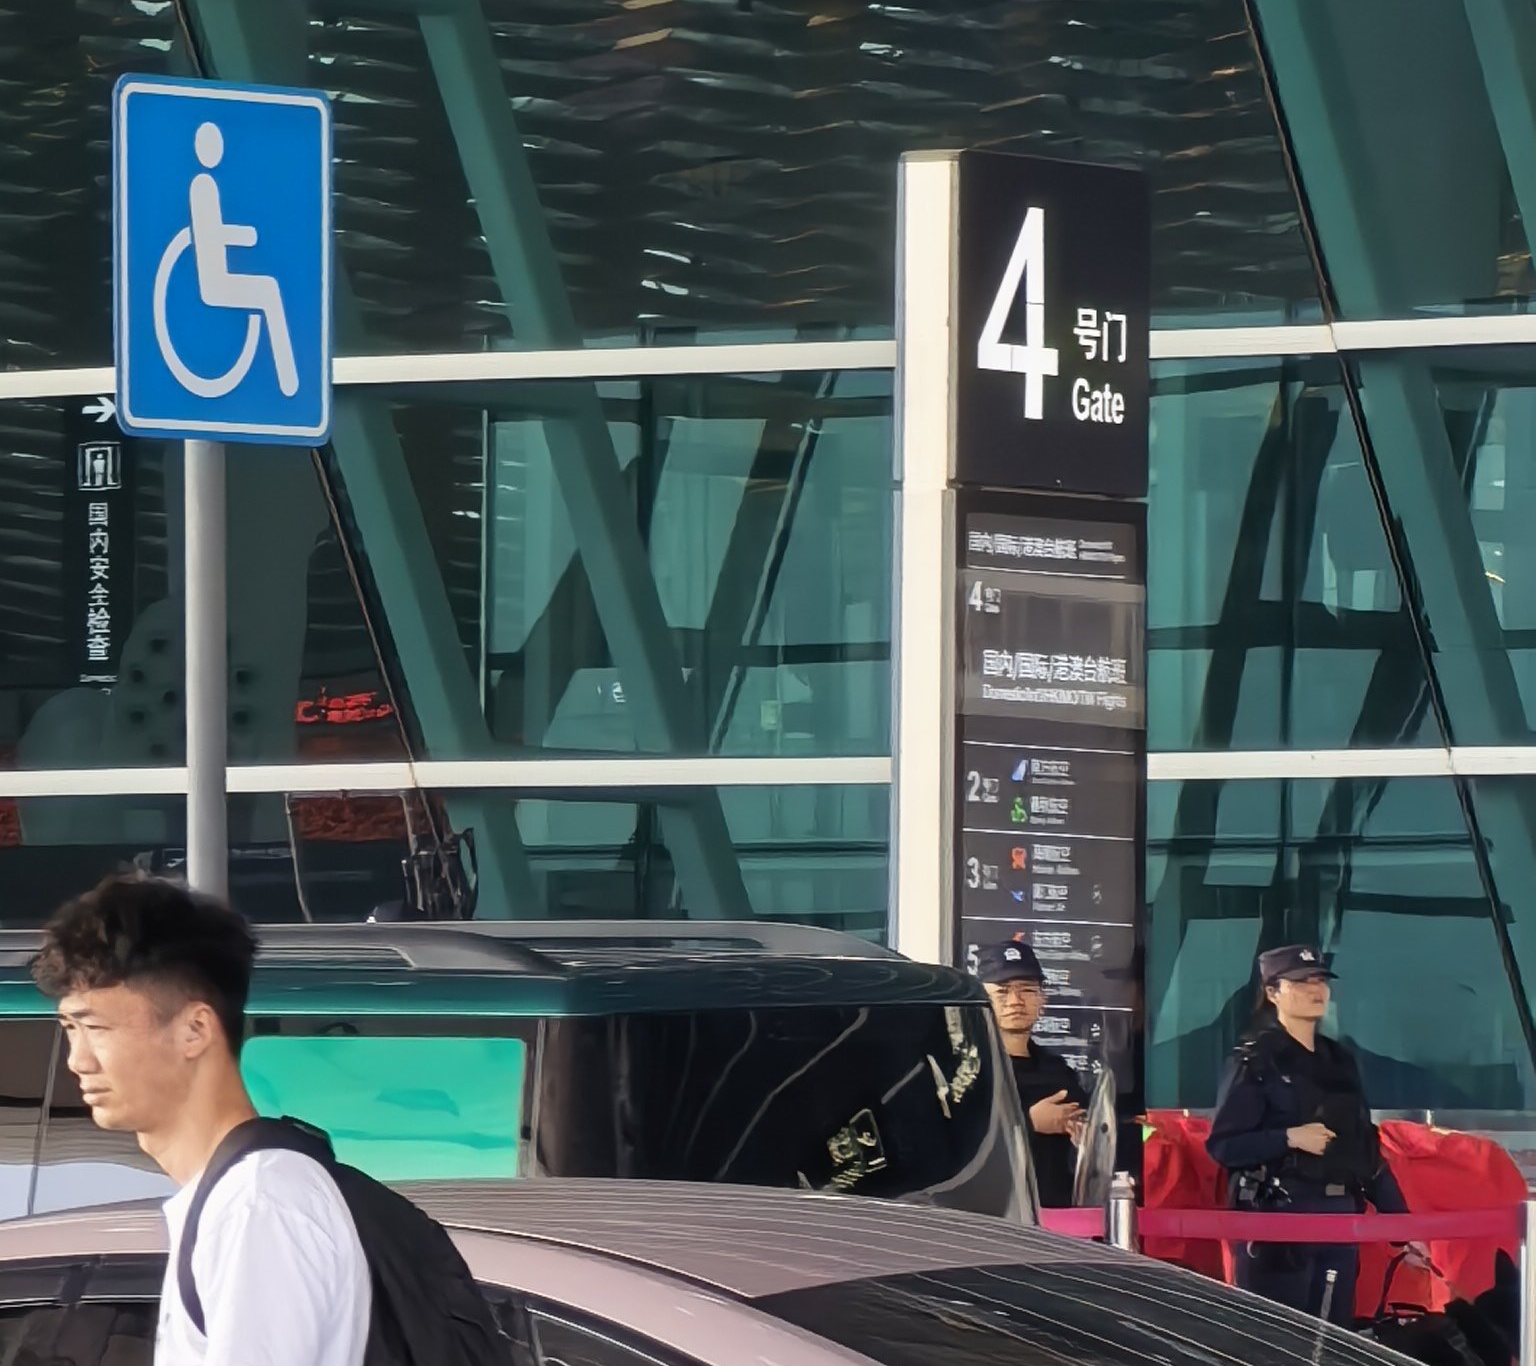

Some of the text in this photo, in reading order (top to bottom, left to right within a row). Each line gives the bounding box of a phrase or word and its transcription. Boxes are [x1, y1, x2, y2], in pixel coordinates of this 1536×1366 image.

[977, 206, 1059, 420] 4
[1072, 307, 1127, 364] 号门
[1071, 376, 1125, 425] Gate
[86, 502, 111, 661] 国内安全检查
[968, 581, 983, 612] 4
[967, 771, 981, 802] 2
[967, 857, 980, 888] 3
